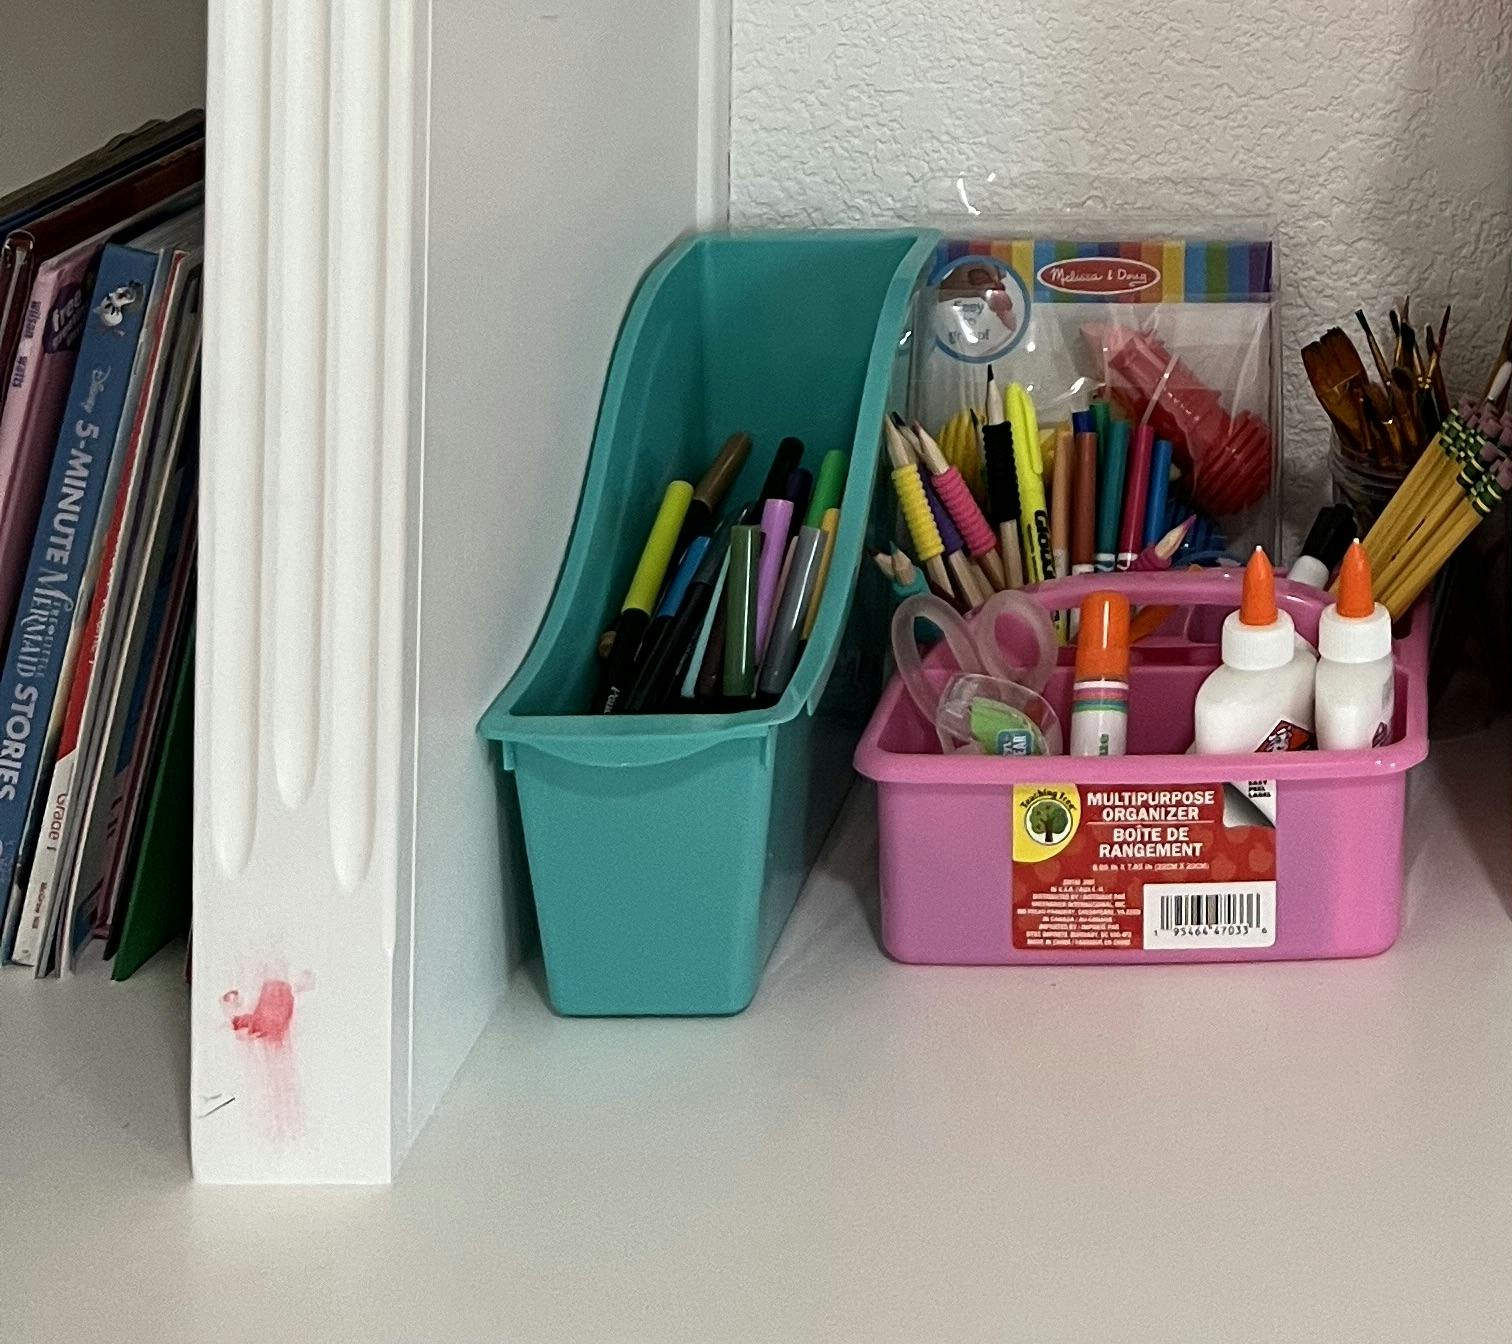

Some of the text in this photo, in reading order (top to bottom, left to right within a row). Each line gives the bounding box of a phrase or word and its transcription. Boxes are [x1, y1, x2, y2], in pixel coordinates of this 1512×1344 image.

[1051, 267, 1104, 284] Melissa
[1117, 268, 1149, 287] Doug
[81, 365, 112, 413] Disney
[45, 419, 100, 566] 5-MINUTE
[17, 566, 75, 678] MERMAID
[0, 682, 39, 802] STORIES
[1087, 791, 1215, 806] MULTIPURPOSE
[1102, 807, 1200, 821] ORGANIZER
[1113, 824, 1189, 842] BOÎTE DE
[1099, 843, 1203, 858] RANGEMENT
